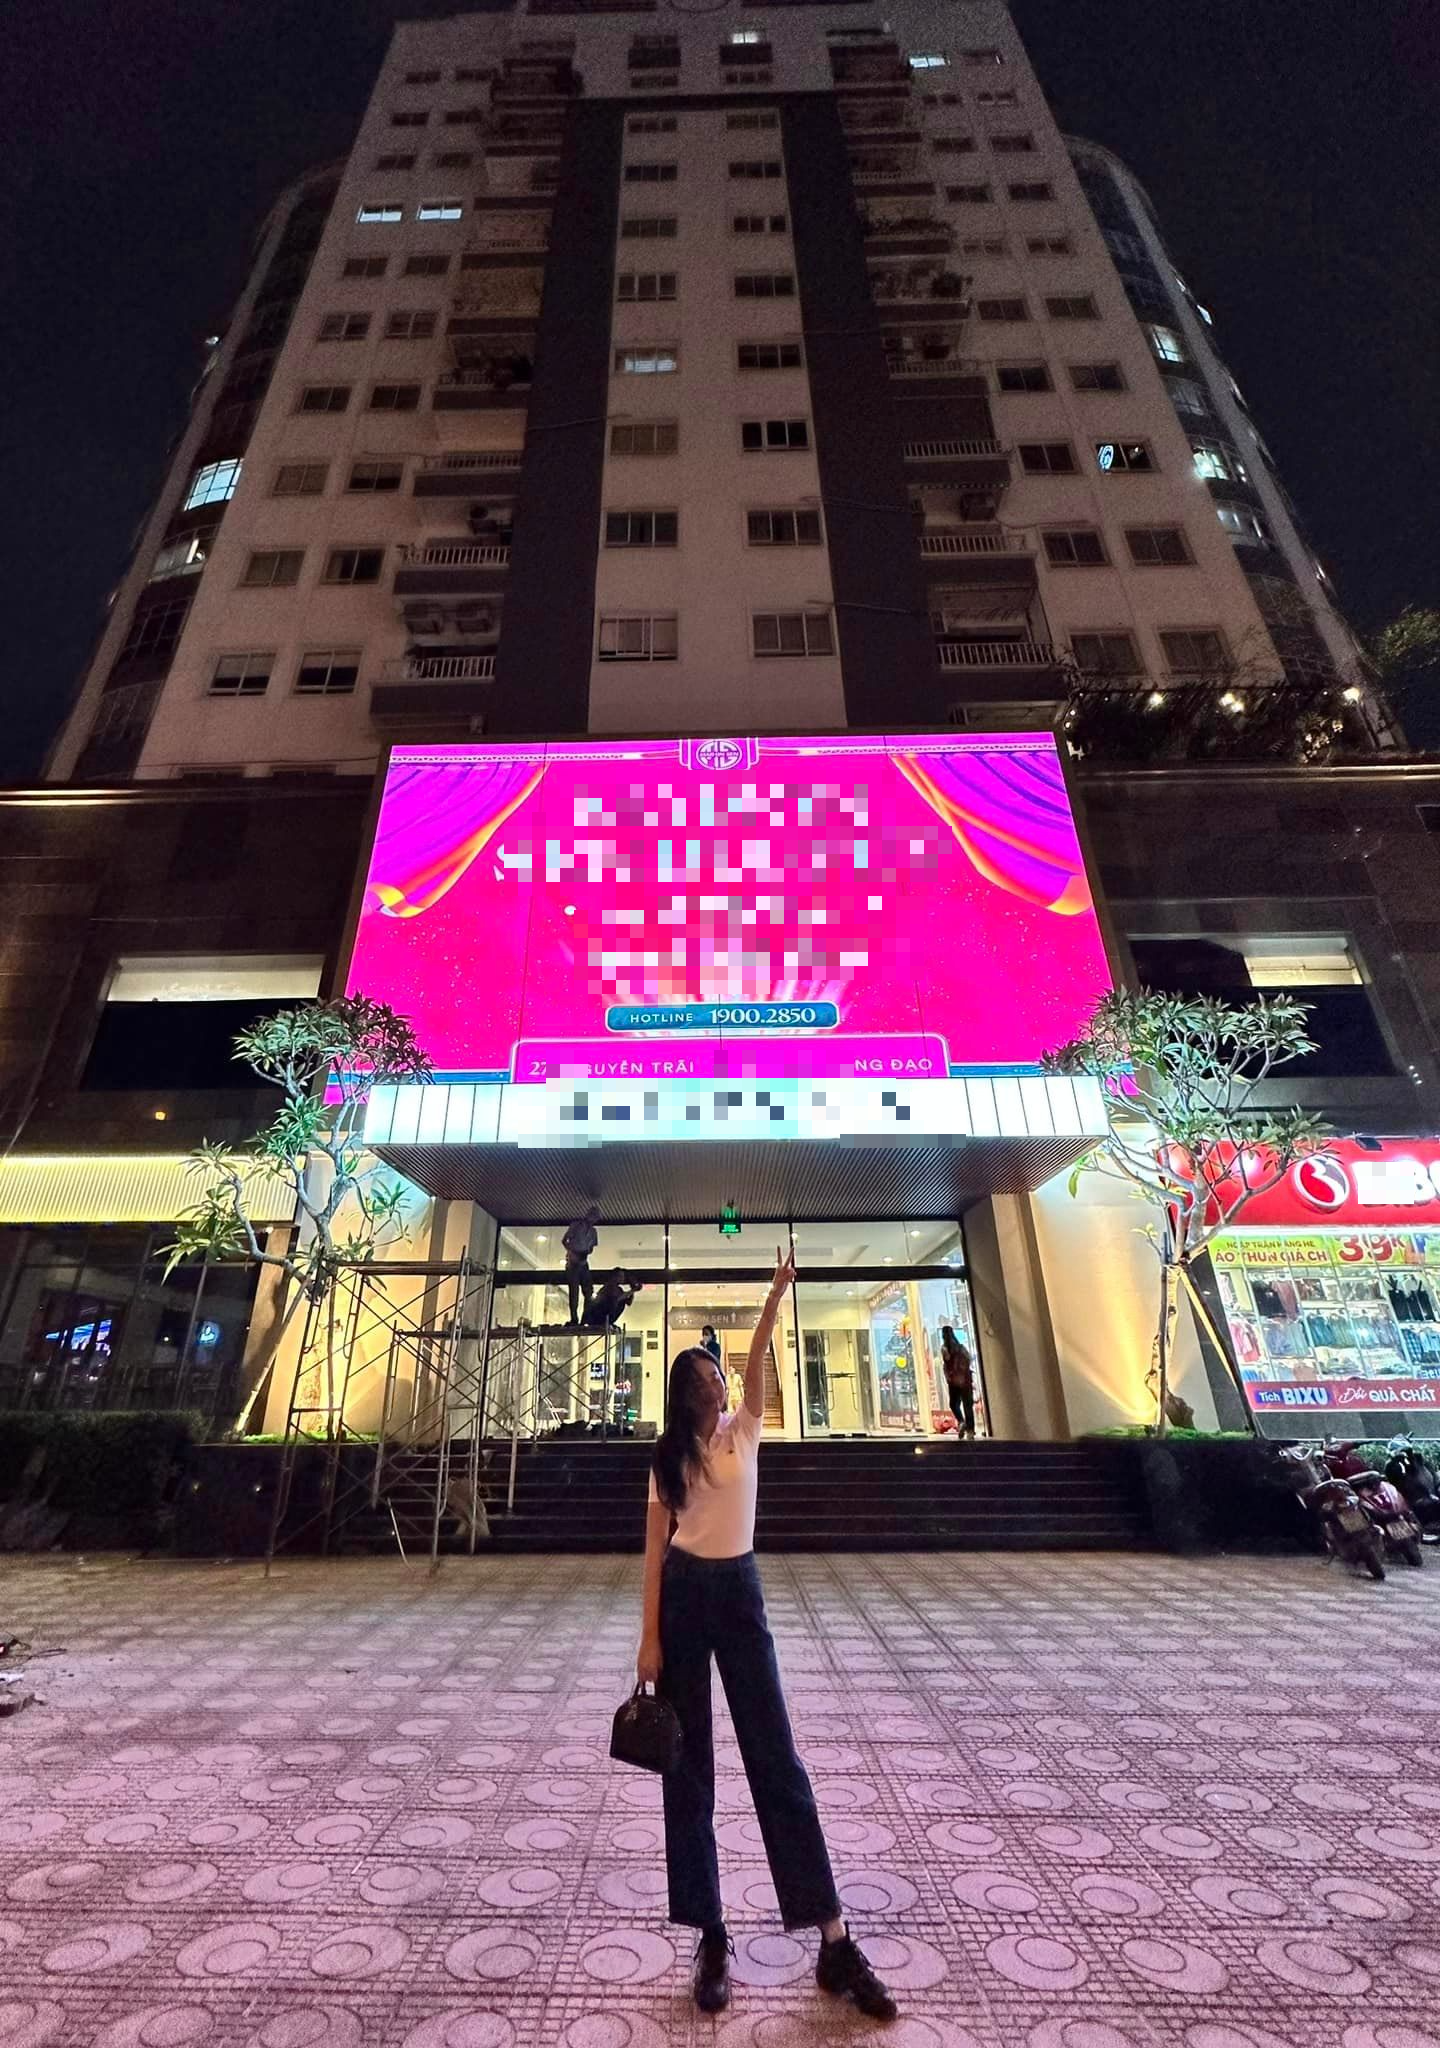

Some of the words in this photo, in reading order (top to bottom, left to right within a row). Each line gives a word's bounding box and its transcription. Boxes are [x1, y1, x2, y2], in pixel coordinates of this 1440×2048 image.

[630, 1013, 693, 1025] HOTLINE
[710, 1008, 816, 1025] 1900.2850
[854, 1058, 883, 1072] NG
[1281, 1387, 1328, 1405] BIXU
[1368, 1386, 1400, 1402] QUÀ
